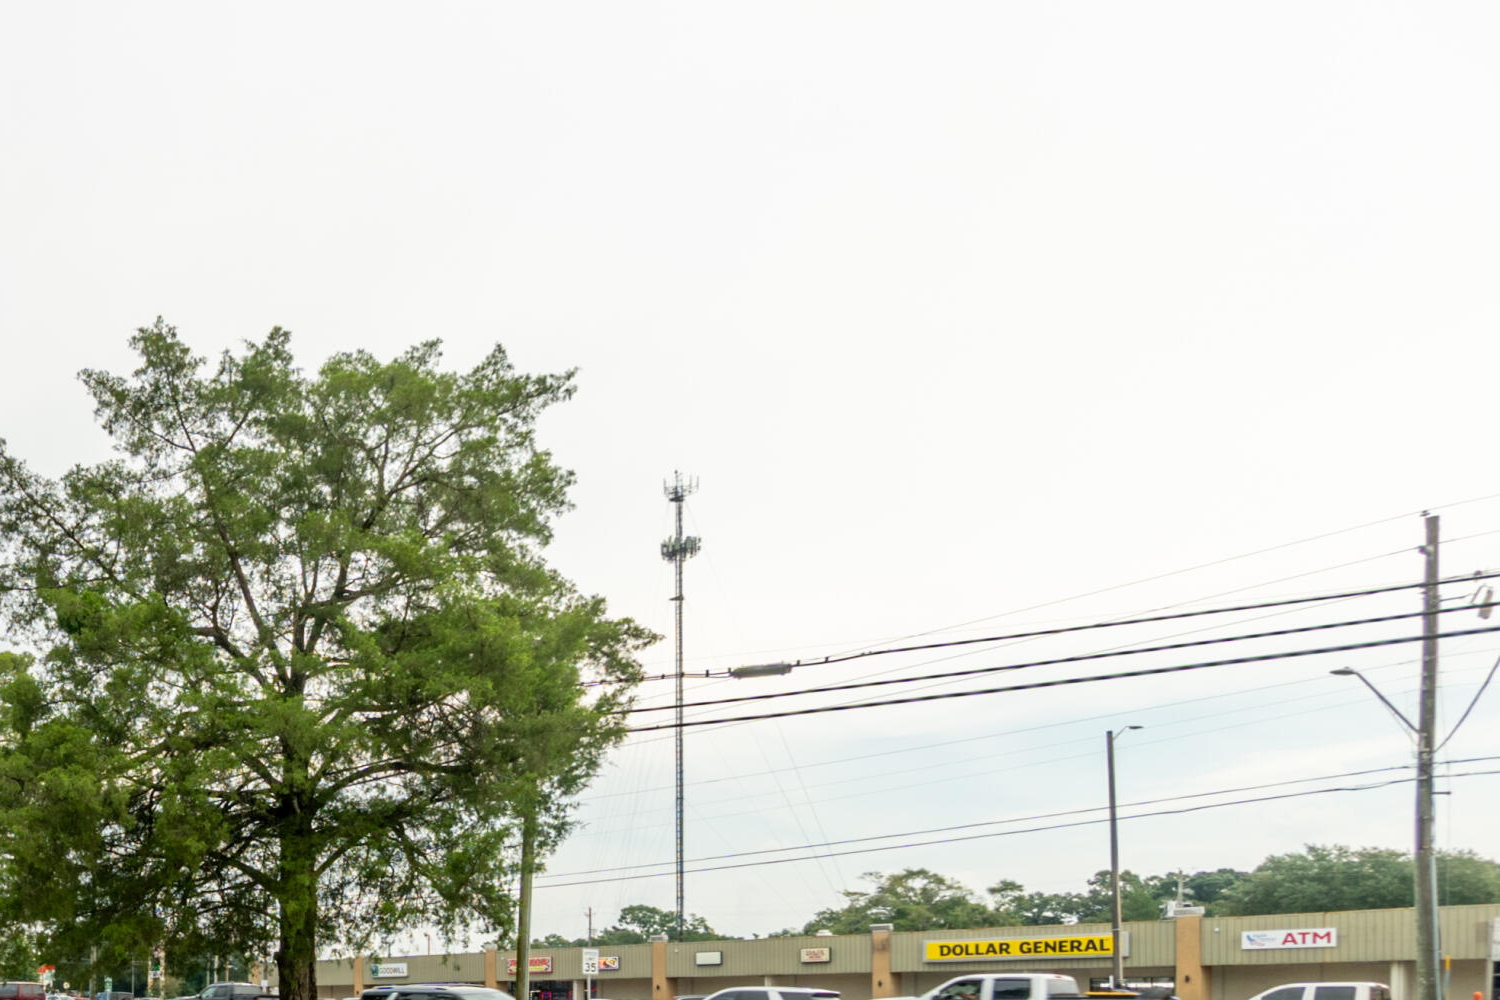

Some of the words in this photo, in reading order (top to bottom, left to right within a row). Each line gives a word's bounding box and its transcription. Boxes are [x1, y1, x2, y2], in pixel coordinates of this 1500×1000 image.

[1282, 931, 1331, 945] ATM
[939, 942, 1010, 957] DOLLAR
[1019, 938, 1110, 954] GENERAL
[584, 962, 597, 973] 35
